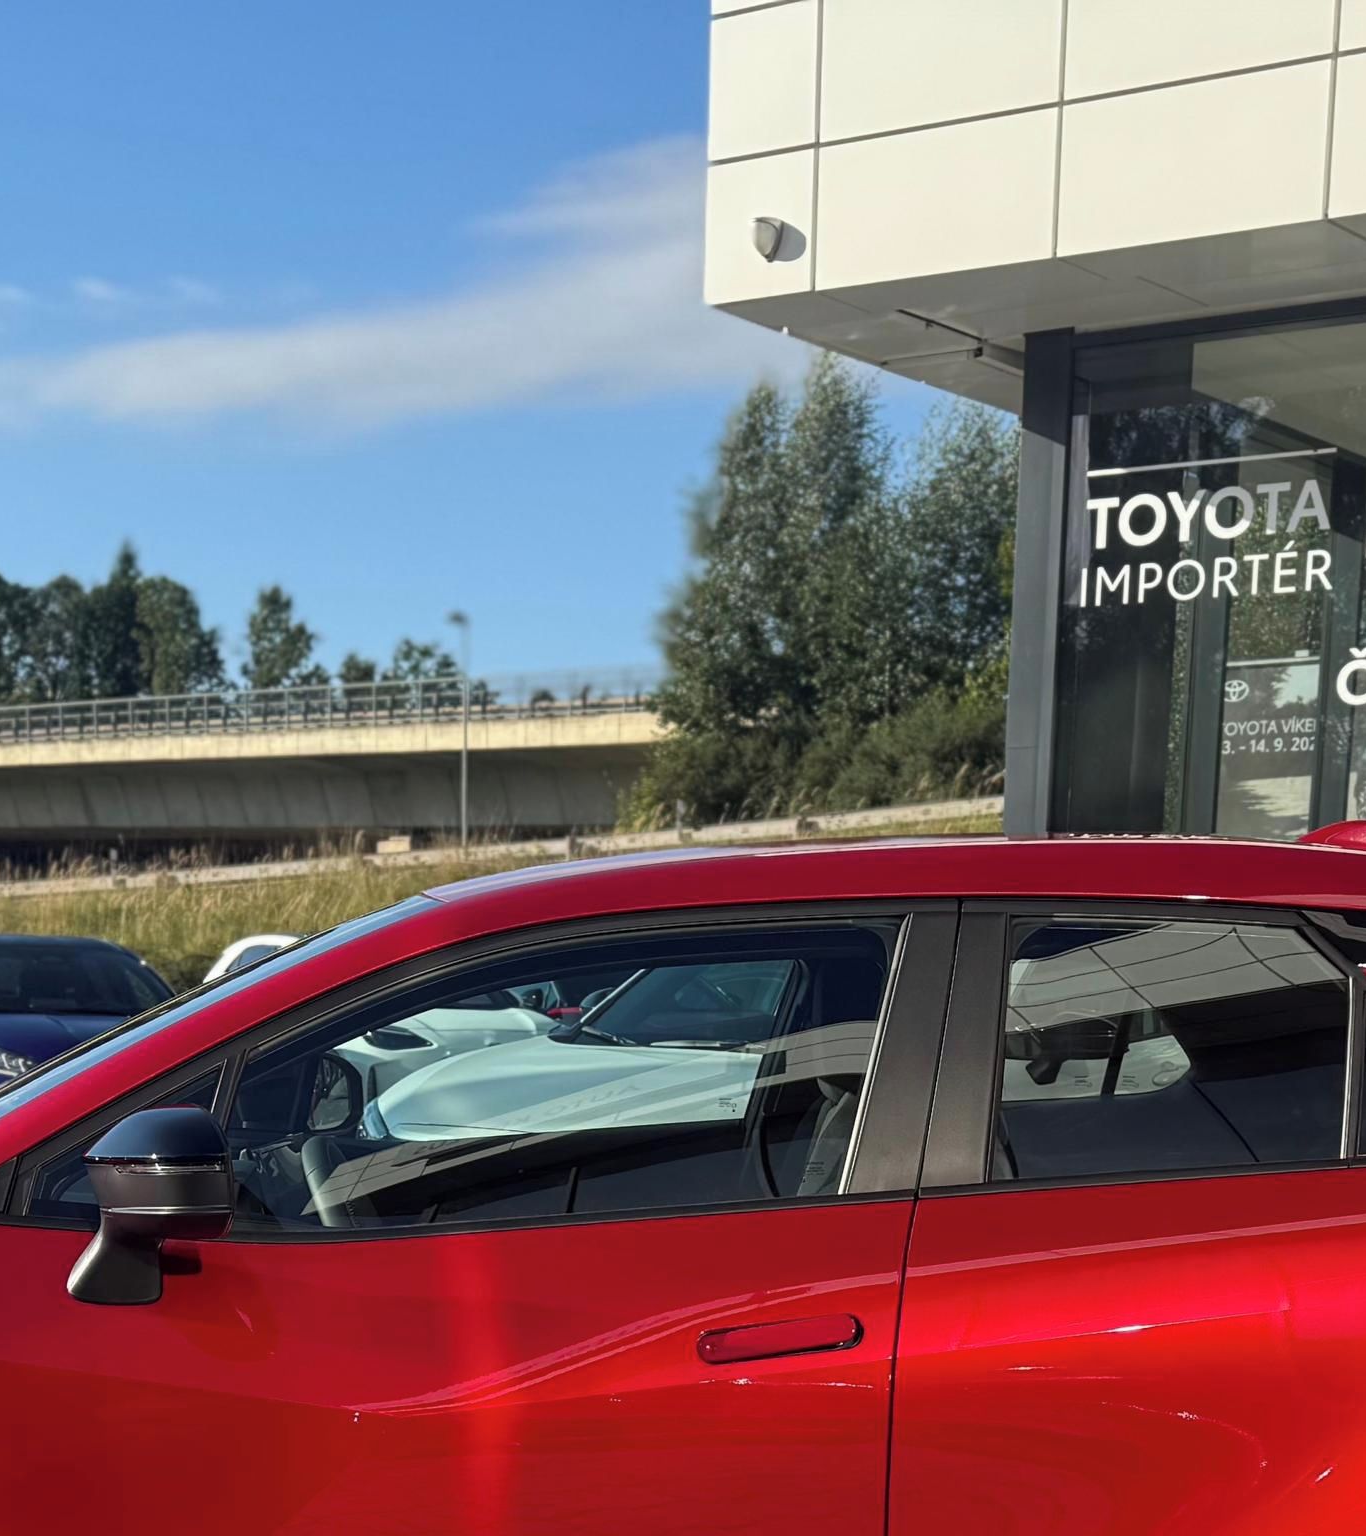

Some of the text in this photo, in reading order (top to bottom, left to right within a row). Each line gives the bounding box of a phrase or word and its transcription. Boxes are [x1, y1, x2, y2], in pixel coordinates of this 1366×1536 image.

[1086, 479, 1331, 549] TOYOTA
[1080, 540, 1333, 608] IMPORTÉR
[1223, 715, 1316, 736] OYOTA VÍKE
[1249, 738, 1269, 753] 14.
[1273, 737, 1287, 752] 9.
